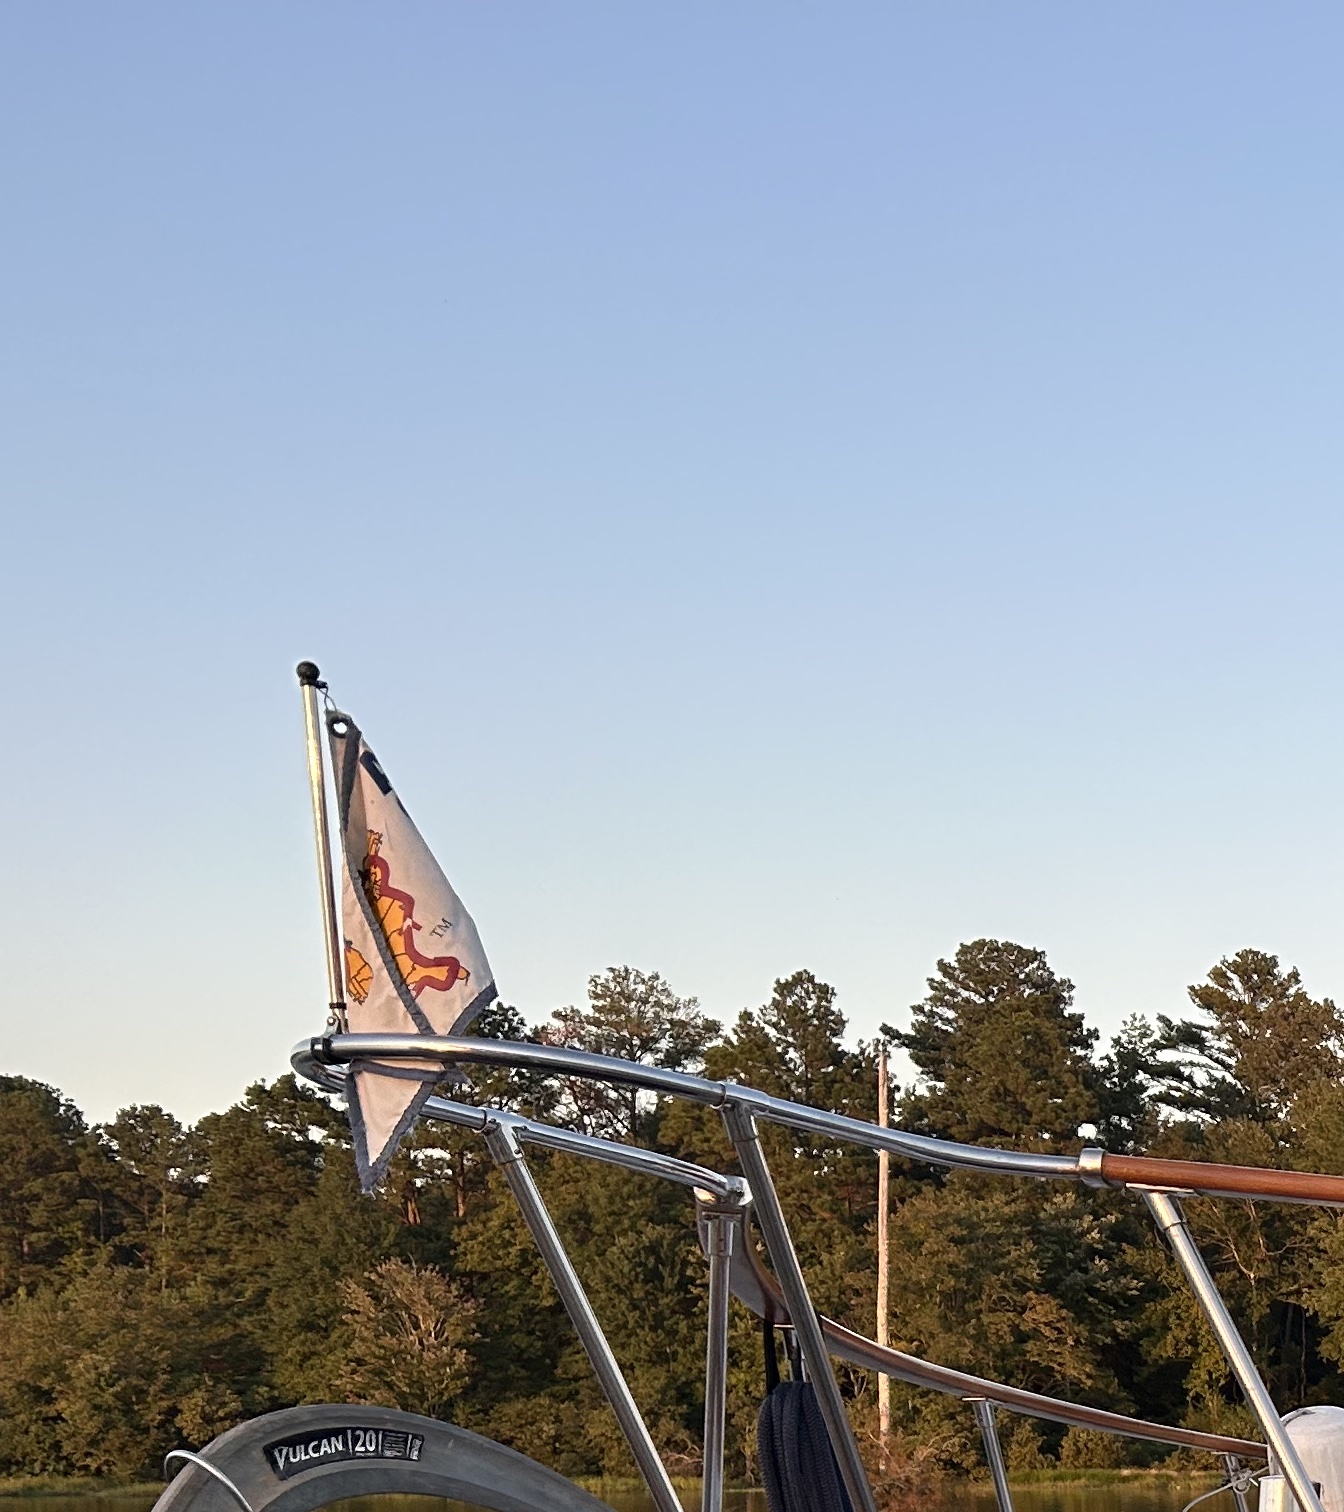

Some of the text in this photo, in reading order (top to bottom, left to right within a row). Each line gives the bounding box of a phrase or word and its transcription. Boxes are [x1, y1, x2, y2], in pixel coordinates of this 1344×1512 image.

[429, 917, 453, 938] TM
[274, 1434, 343, 1471] VULCAN
[355, 1430, 377, 1452] 20
